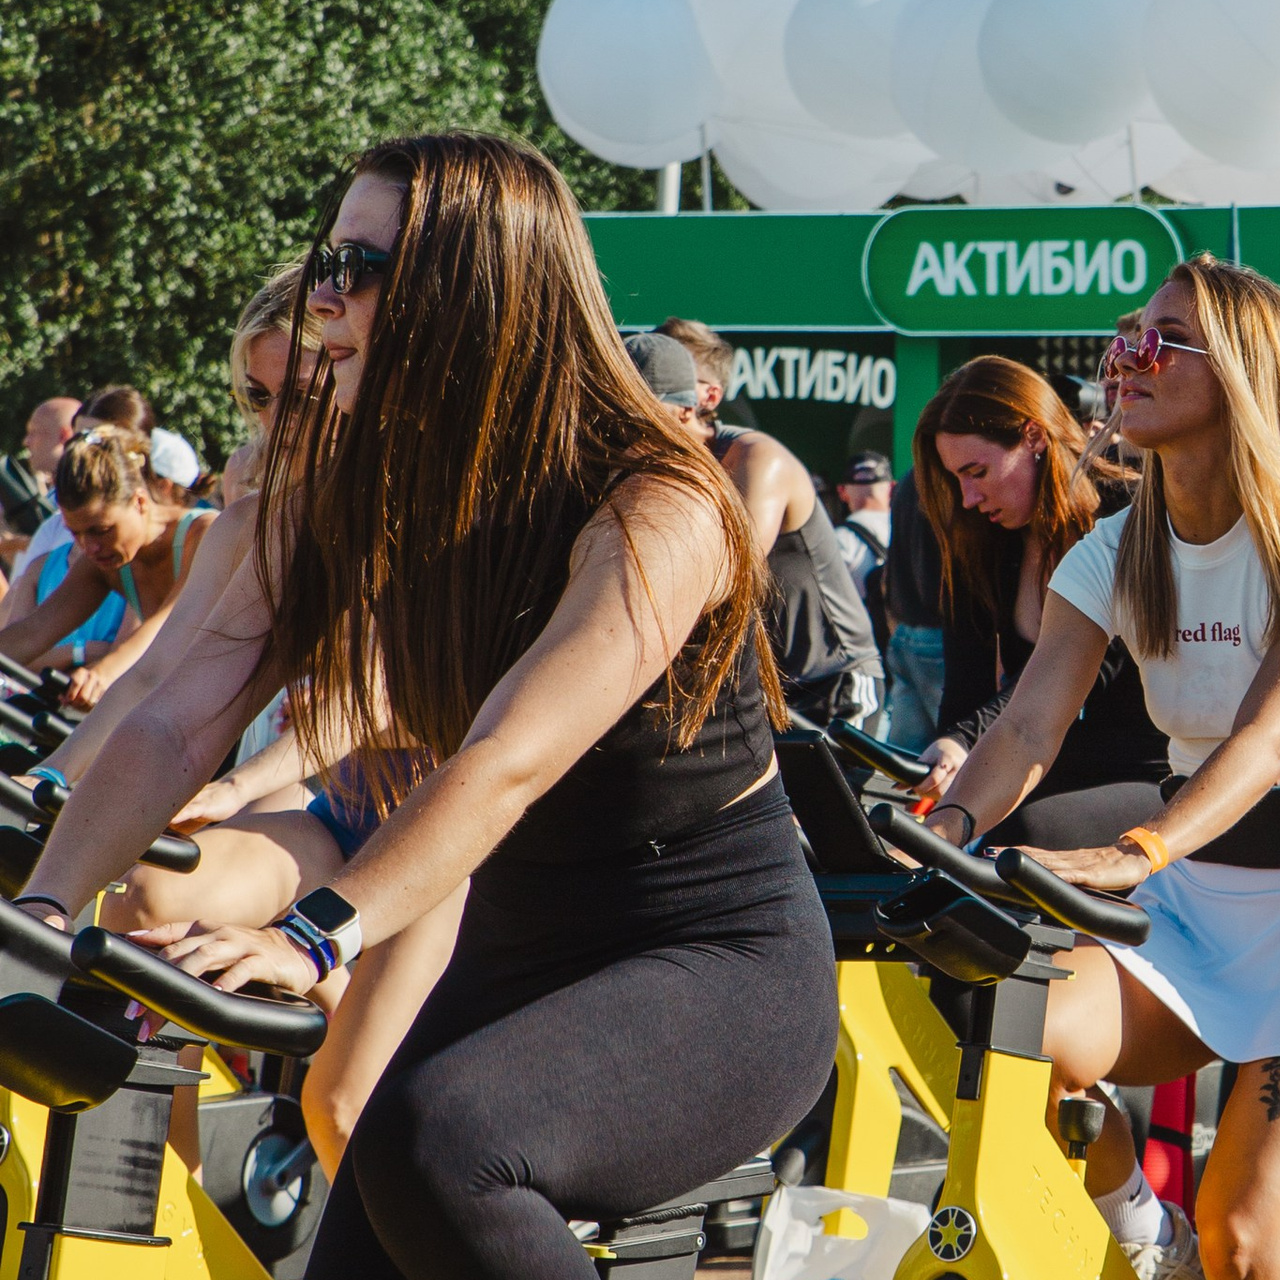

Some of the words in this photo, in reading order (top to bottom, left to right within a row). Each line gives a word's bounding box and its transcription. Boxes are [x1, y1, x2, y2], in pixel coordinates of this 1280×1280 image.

[906, 239, 1147, 297] АКТИБИО
[726, 347, 897, 409] АКТИБИО
[1174, 622, 1206, 642] red
[1210, 622, 1241, 646] flag
